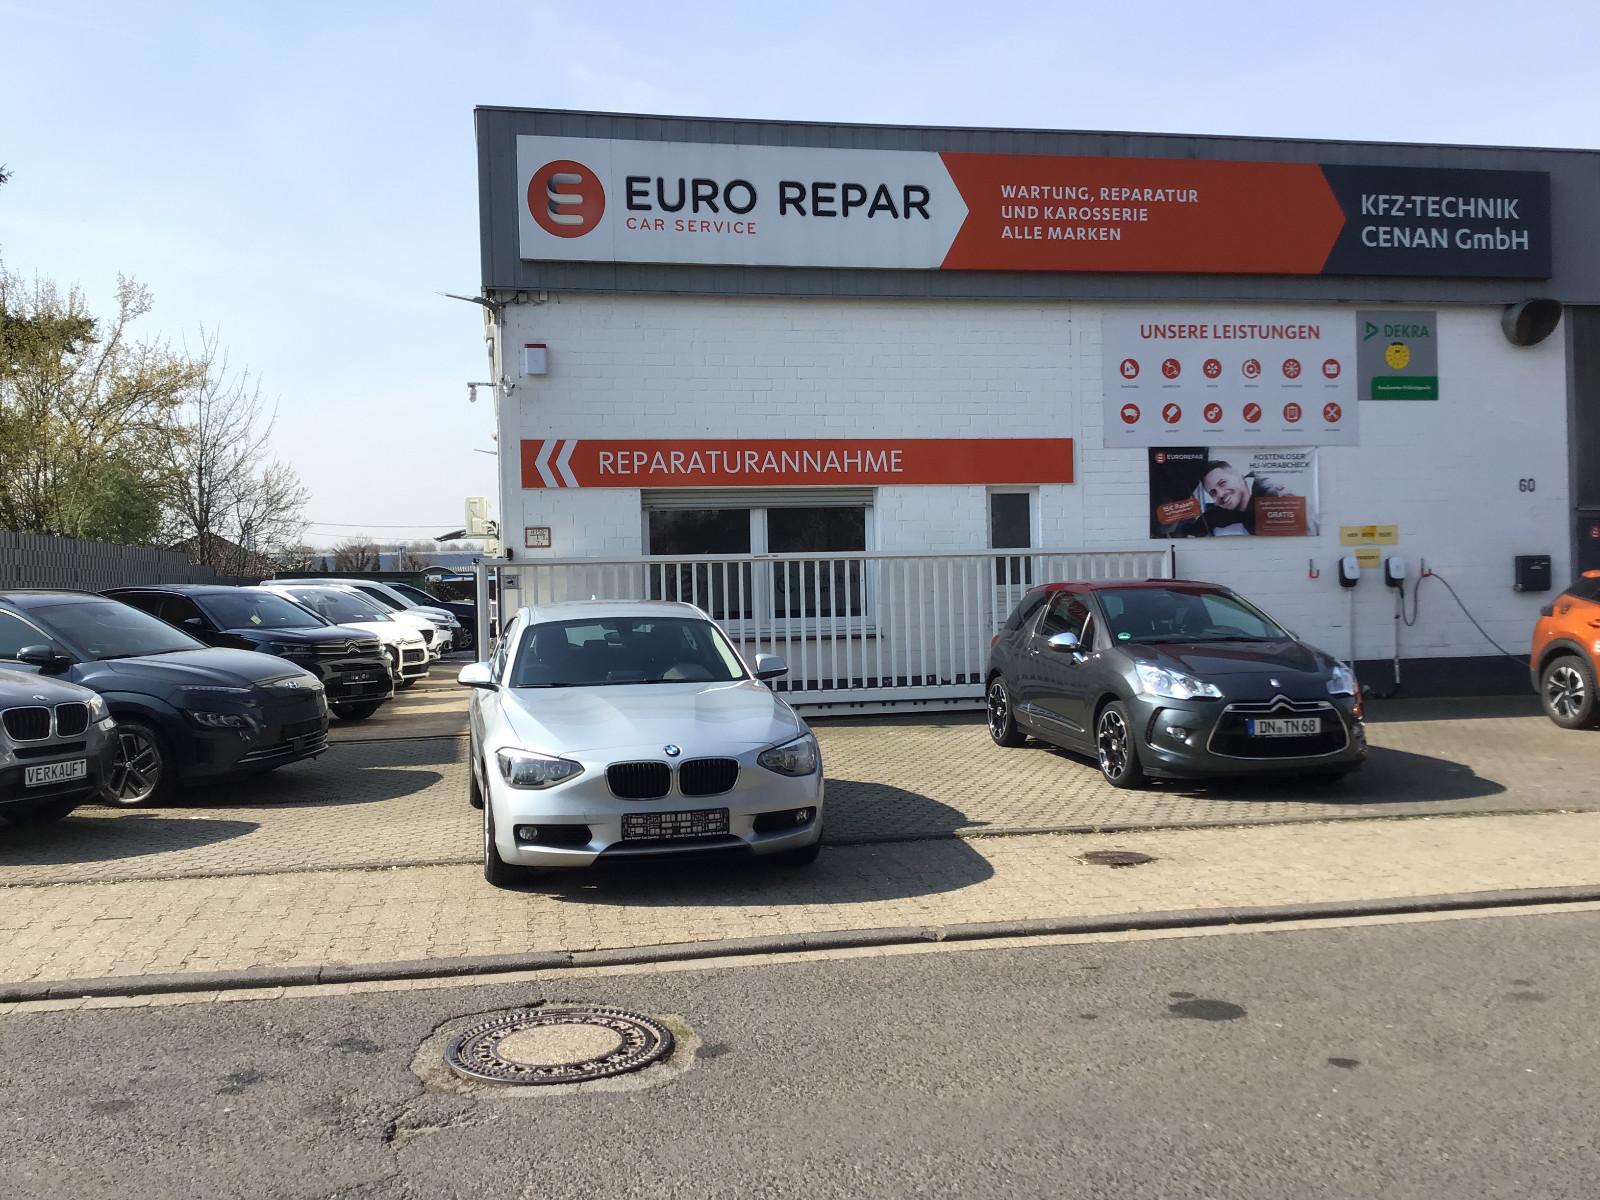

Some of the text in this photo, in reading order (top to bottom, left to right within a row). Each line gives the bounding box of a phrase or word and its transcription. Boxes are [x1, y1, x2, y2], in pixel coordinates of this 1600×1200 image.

[625, 175, 931, 220] EURO REPAR
[1000, 184, 1199, 204] WARTUNG, REPARATUR
[1001, 205, 1149, 222] UND KAROSSERIE
[1361, 193, 1520, 220] KFZ-TECHNIK
[626, 217, 757, 235] CAR SERVICE
[1001, 224, 1121, 241] ALLE MARKEN
[1361, 225, 1530, 251] CENAN GmbH
[1140, 323, 1320, 340] UNSERE LEISTUNGEN
[1384, 324, 1430, 338] DEKRA
[599, 449, 904, 475] REPARATURANNAHME
[1519, 478, 1536, 493] 60
[1266, 511, 1296, 519] GRATIS
[1259, 720, 1276, 733] DN
[27, 761, 86, 783] VERKAUFT
